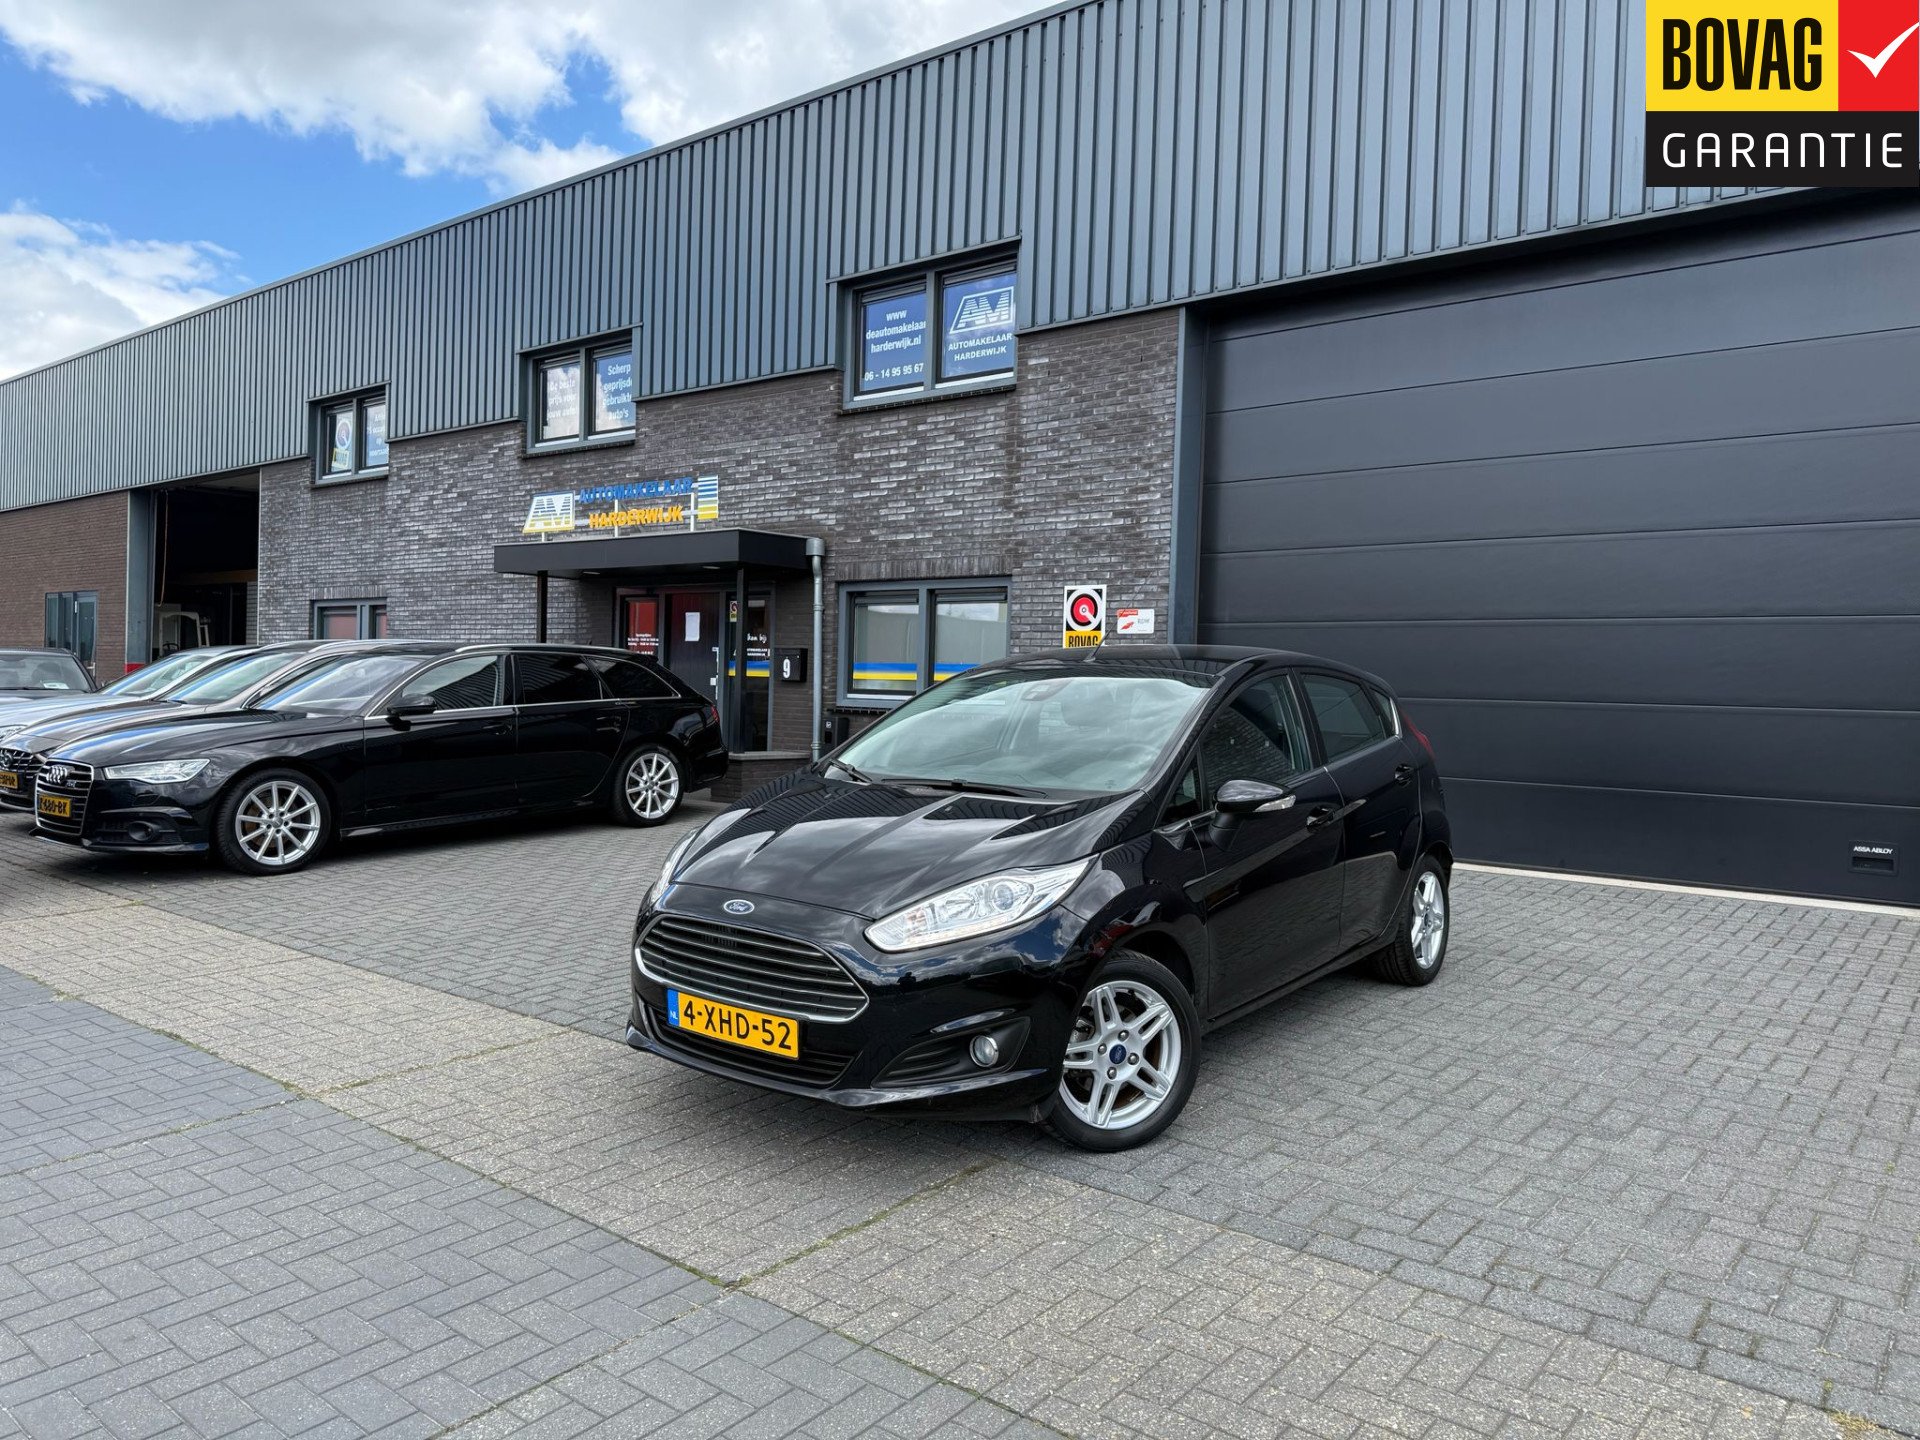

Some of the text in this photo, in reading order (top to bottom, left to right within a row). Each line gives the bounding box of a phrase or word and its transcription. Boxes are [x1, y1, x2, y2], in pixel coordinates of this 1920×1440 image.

[886, 310, 907, 321] www
[871, 335, 922, 353] harderwijk.nl
[948, 332, 1013, 351] AUTOMAKELAAR
[954, 345, 1007, 361] HARDERWIJK
[607, 363, 631, 376] Scherp
[864, 371, 874, 382] 06
[881, 368, 890, 378] 14
[891, 365, 901, 377] 95
[902, 364, 912, 375] 95
[914, 362, 924, 373] 67
[603, 376, 632, 393] geprijsd
[602, 392, 632, 408] gebruikt
[578, 477, 694, 504] AUTOMAKELAAR
[588, 505, 684, 529] HARDERWIJK
[782, 658, 791, 678] 9
[670, 1000, 792, 1050] NL 4-XHD-52
